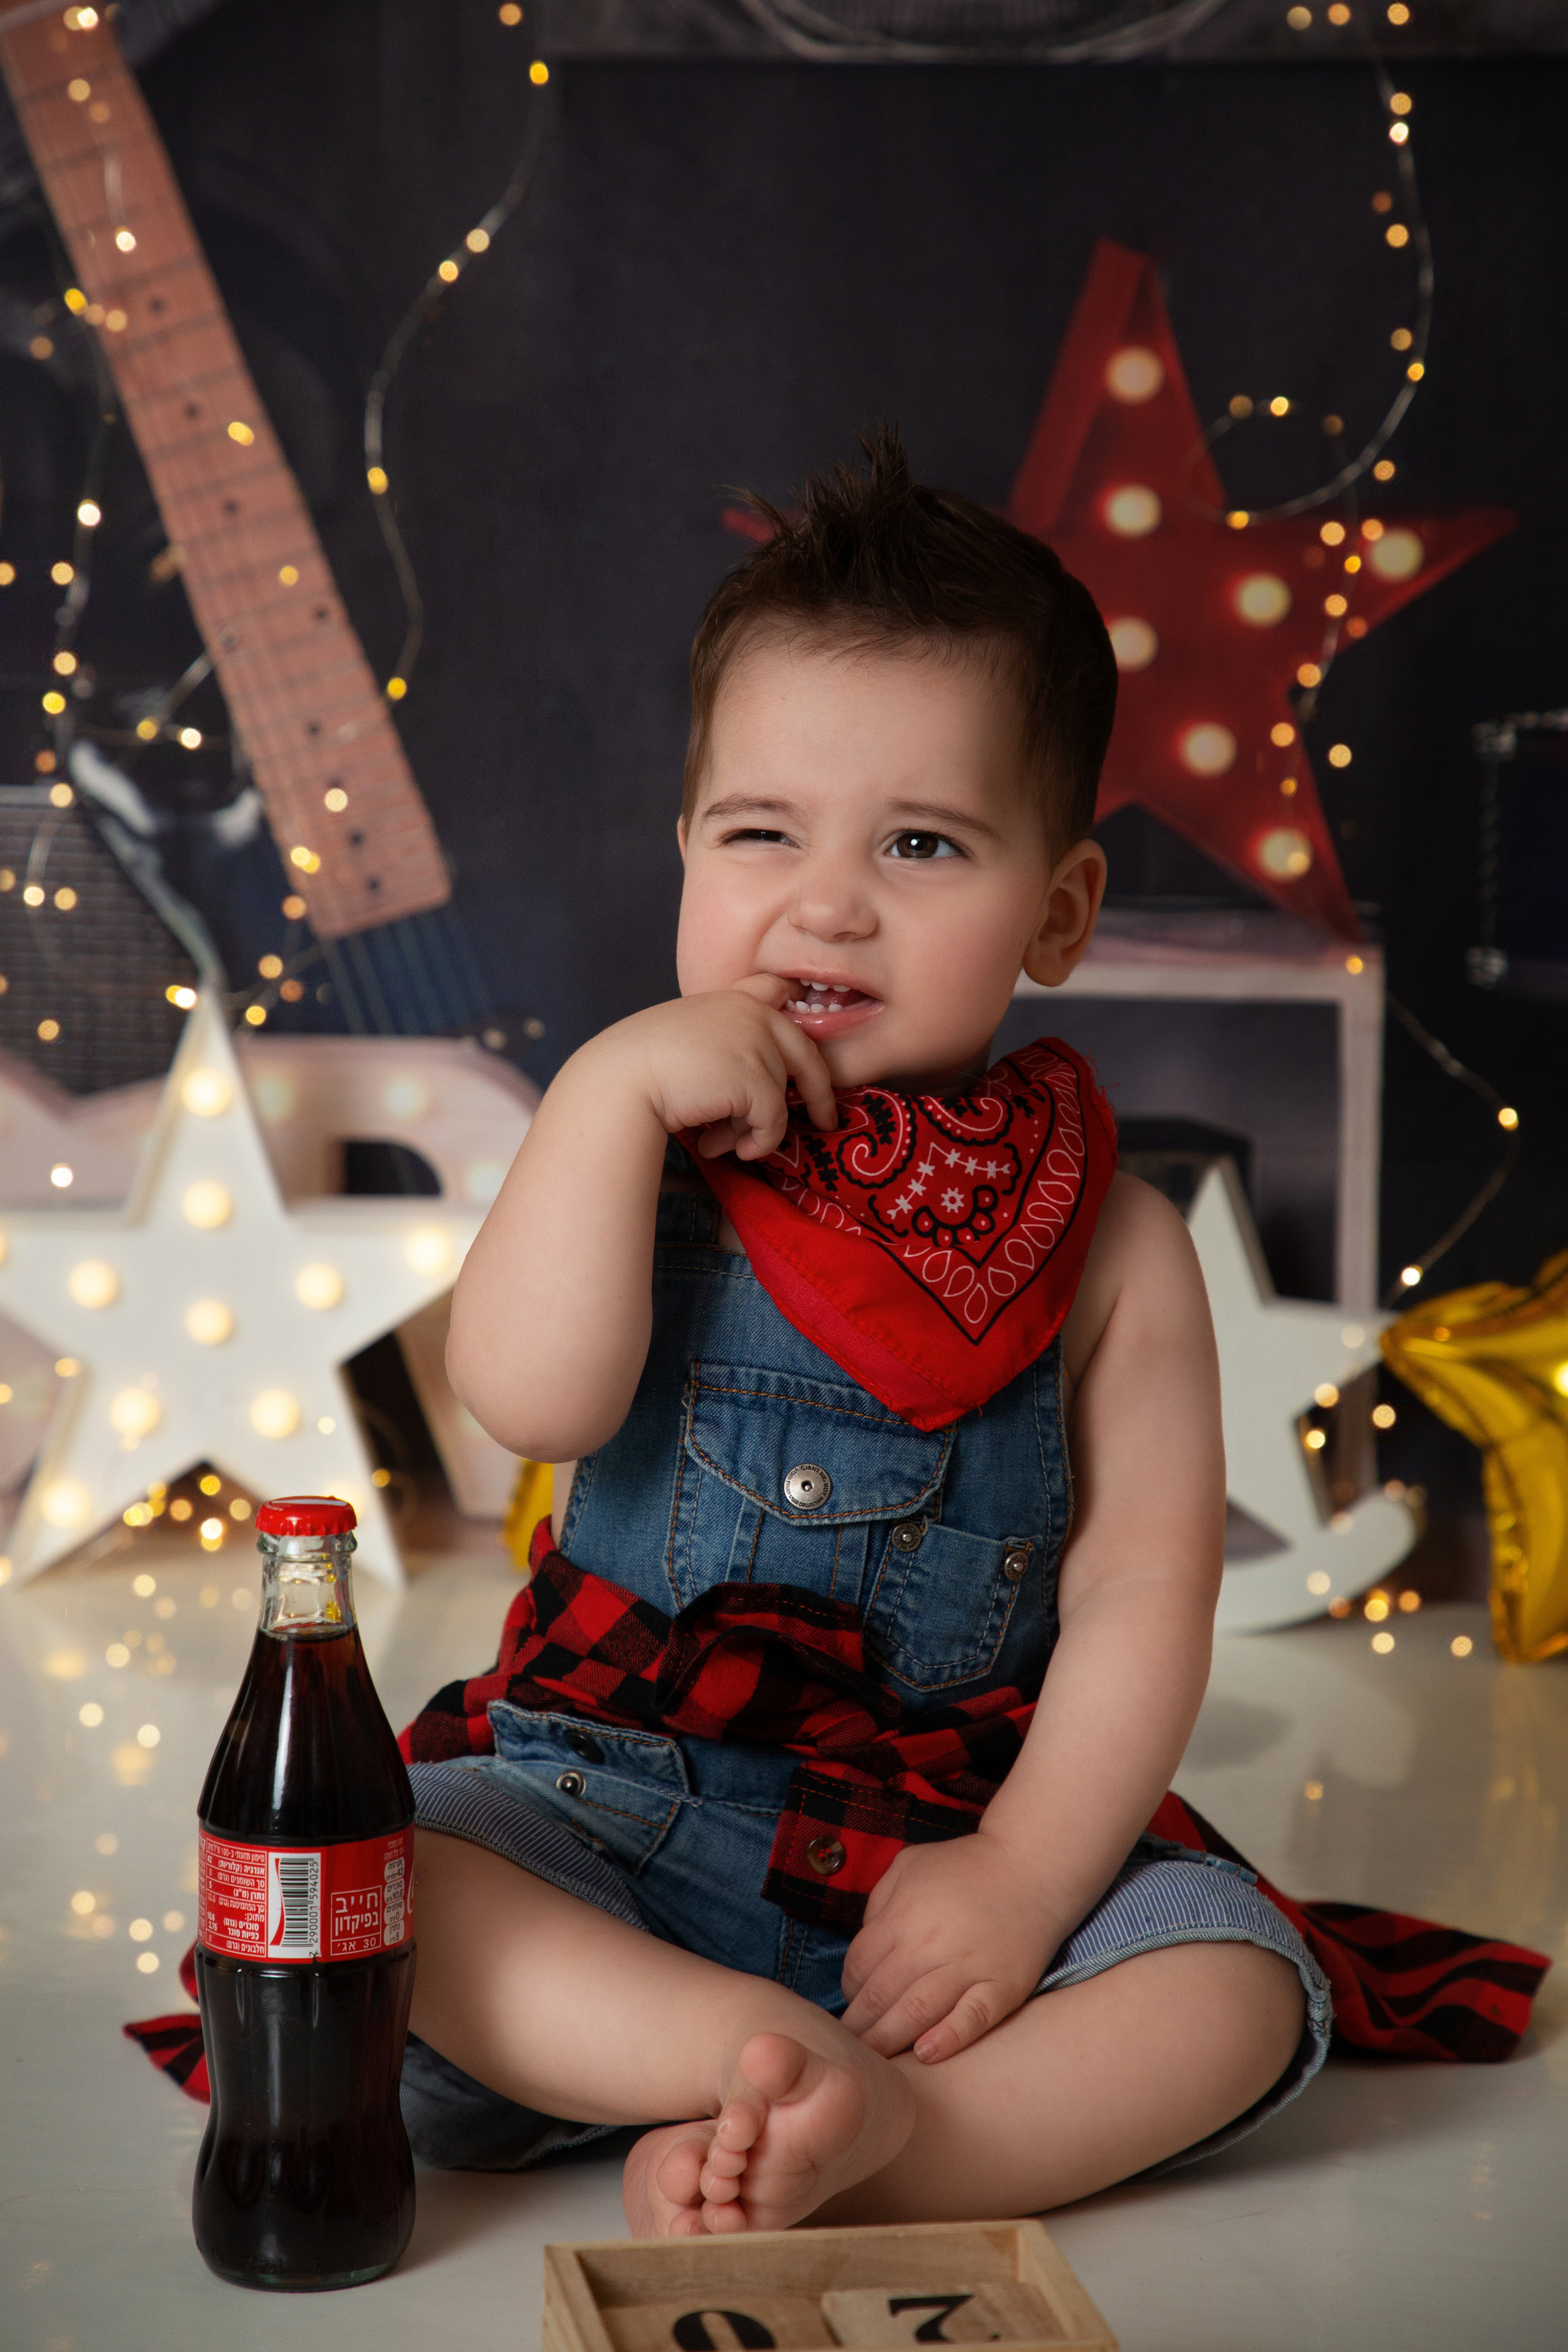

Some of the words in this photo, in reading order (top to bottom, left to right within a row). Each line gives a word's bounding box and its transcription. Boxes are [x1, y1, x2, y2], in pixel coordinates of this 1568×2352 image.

[820, 1472, 828, 1481] BIG
[799, 1497, 824, 1507] COLLECTION
[219, 1860, 242, 1872] (קלוריות)
[244, 1866, 265, 1875] אנרגיה
[217, 1872, 229, 1882] (גרם)
[397, 1868, 403, 1876] 42
[231, 1876, 255, 1886] השומנים
[257, 1879, 265, 1888] סך
[387, 1881, 402, 1893] סוכרים
[251, 1891, 265, 1900] נתרן
[393, 1890, 403, 1900] 10.6
[219, 1897, 229, 1907] (גרם)
[336, 1893, 378, 1913] חייב
[386, 1902, 403, 1913] שומנים
[245, 1913, 264, 1922] מתוכן:
[396, 1911, 399, 1920] 0
[208, 1921, 217, 1931] 2.75
[224, 1917, 237, 1928] (גרם)
[239, 1922, 258, 1931] סוכרים
[335, 1911, 379, 1936] בפיקדון
[228, 1928, 241, 1937] סוכר
[390, 1923, 400, 1934] נתרן
[241, 1930, 258, 1940] כפיות
[396, 1932, 399, 1941] 5
[226, 1940, 240, 1951] (גרם)
[363, 1937, 376, 1948] 30
[241, 1943, 264, 1953] חלבונים
